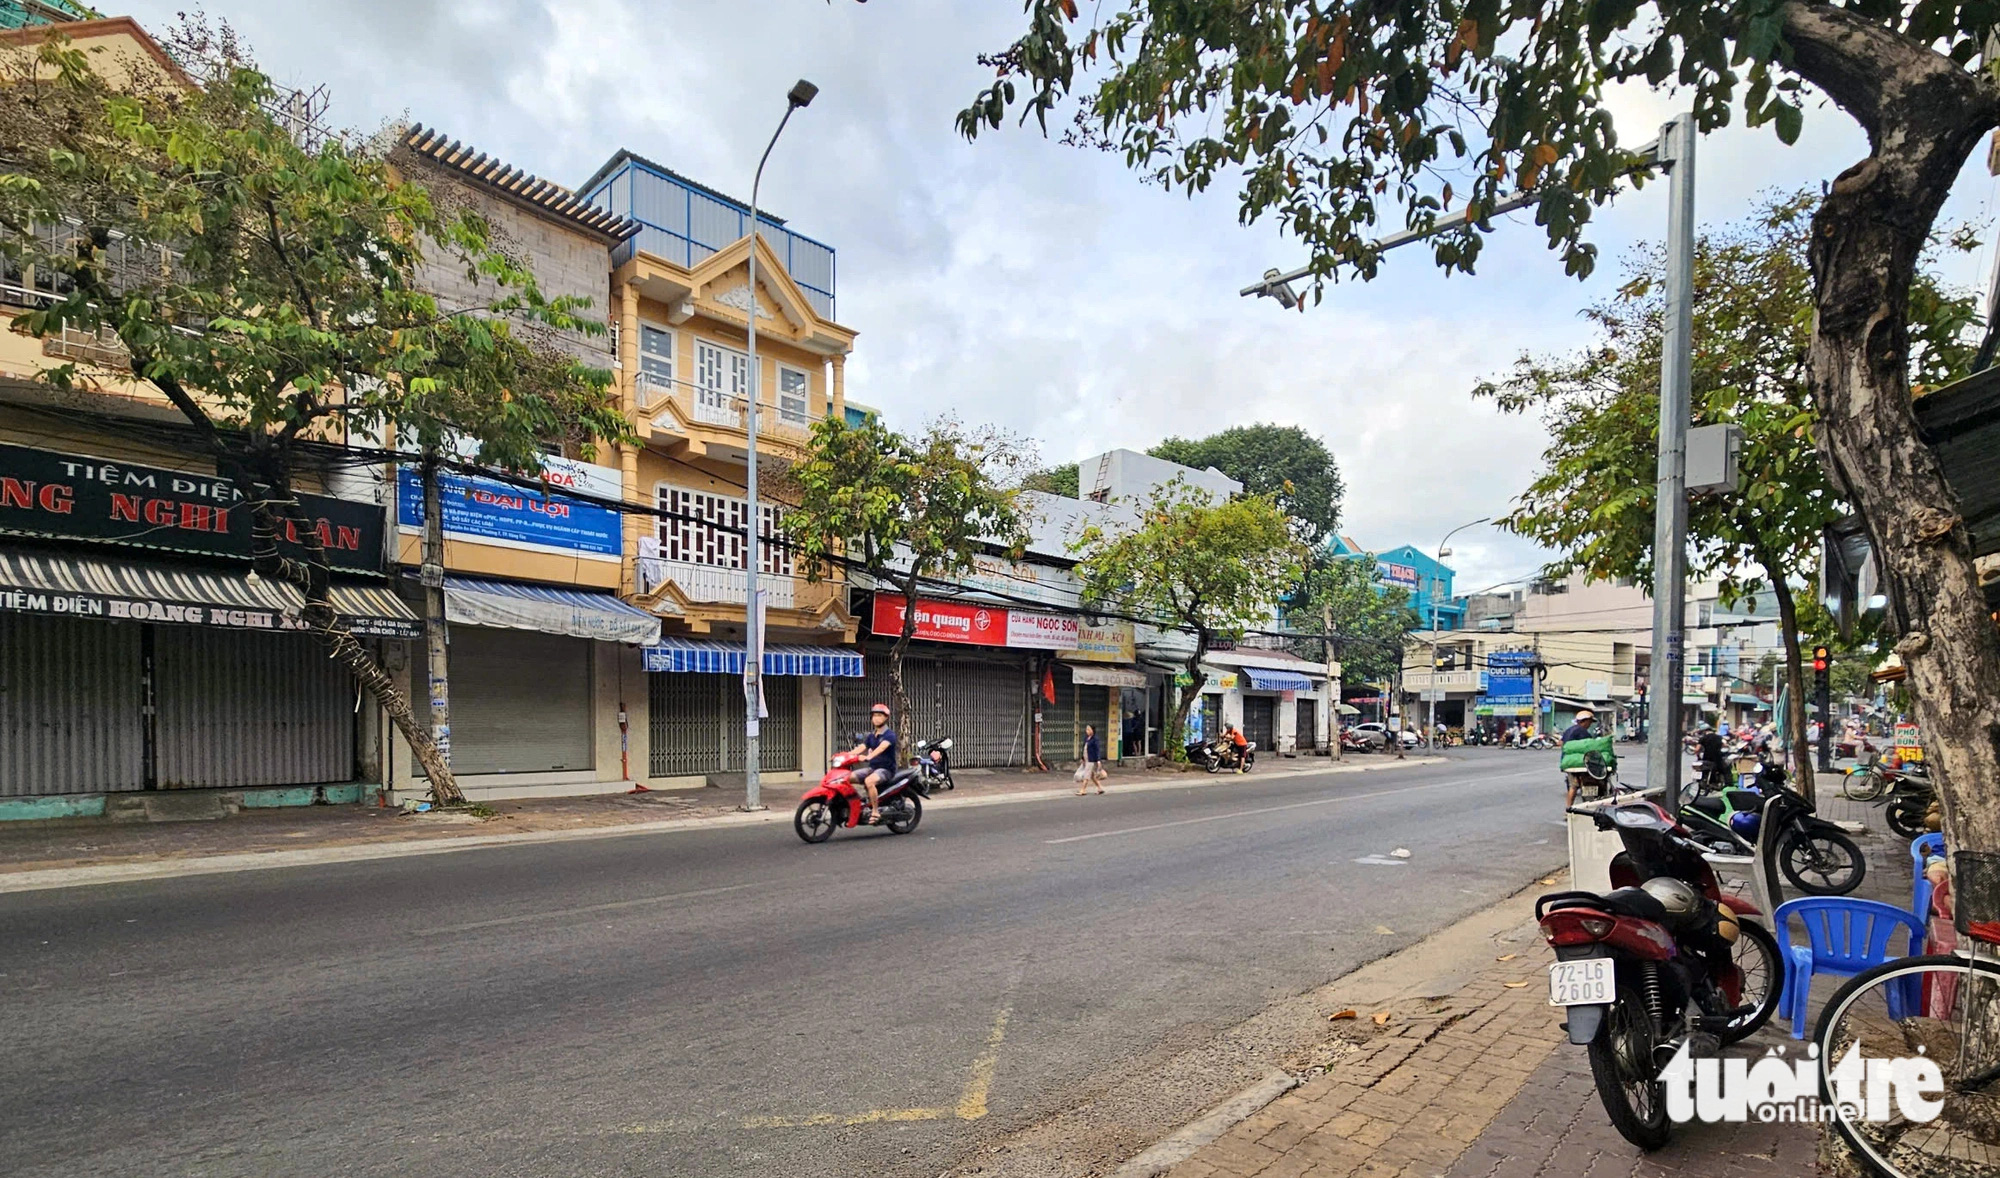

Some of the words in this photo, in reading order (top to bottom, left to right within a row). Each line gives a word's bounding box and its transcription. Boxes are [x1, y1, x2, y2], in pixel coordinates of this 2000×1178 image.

[59, 460, 157, 489] TIỆM
[110, 492, 229, 534] NGHI
[53, 595, 103, 617] ĐIỆN
[109, 600, 204, 624] HOÀNG
[211, 608, 273, 629] NGHI
[932, 613, 971, 632] quang
[1036, 617, 1059, 634] NGỌC
[1559, 962, 1604, 984] 72-L6
[1559, 981, 1605, 1002] 2609
